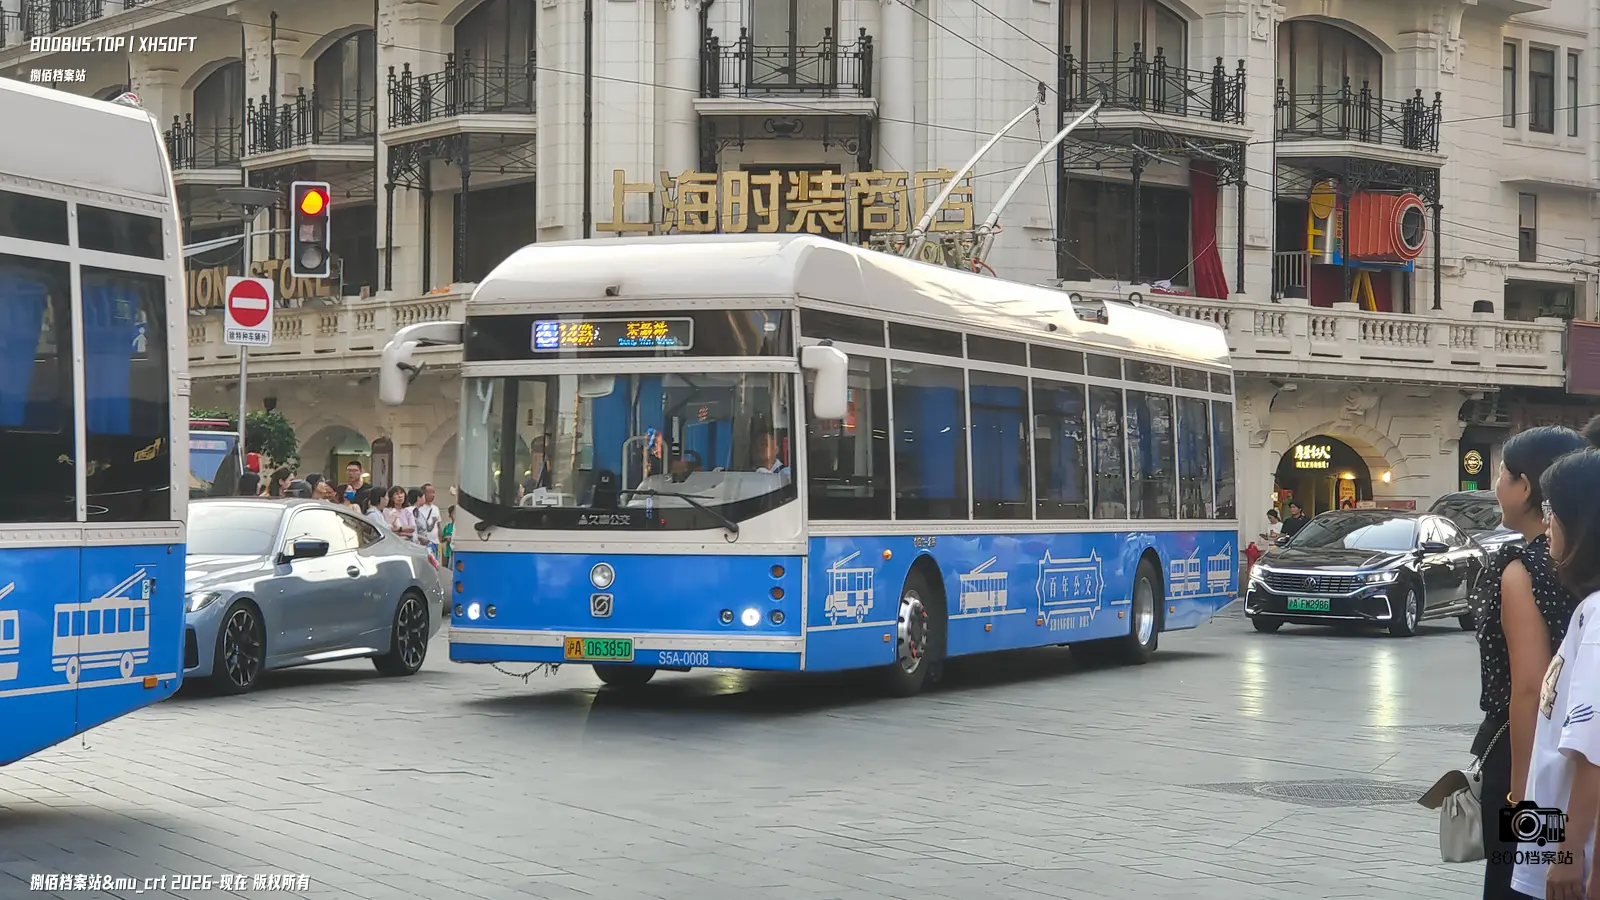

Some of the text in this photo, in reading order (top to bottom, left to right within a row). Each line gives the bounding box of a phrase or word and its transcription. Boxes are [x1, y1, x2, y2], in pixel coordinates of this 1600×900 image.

[596, 168, 974, 234] 上海时装商店
[185, 265, 228, 309] ION
[1050, 573, 1092, 598] 百年公交
[587, 640, 631, 657] 06385D
[659, 651, 709, 666] S5A-0008
